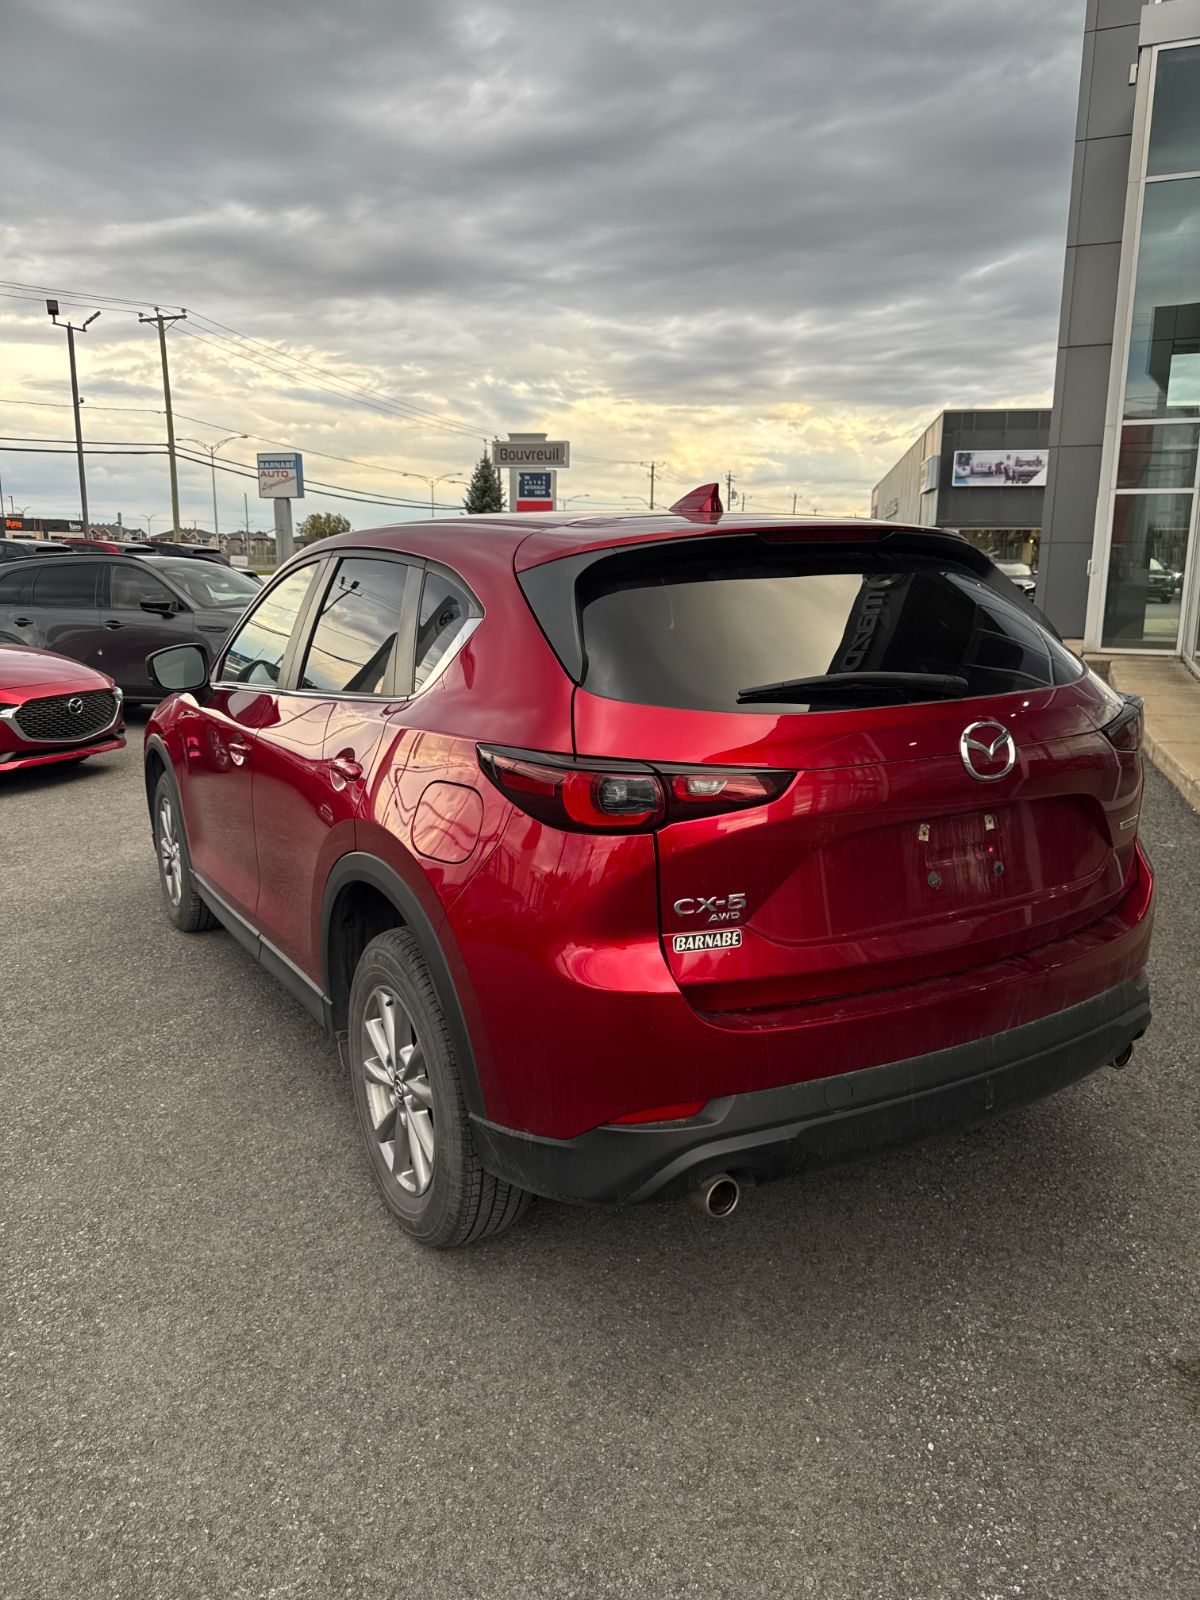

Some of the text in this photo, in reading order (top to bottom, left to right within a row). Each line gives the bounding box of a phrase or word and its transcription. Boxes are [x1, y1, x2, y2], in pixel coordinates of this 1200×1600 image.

[500, 447, 559, 461] Bouvreuil
[260, 470, 289, 478] AUTO
[673, 893, 747, 915] CX-5
[708, 911, 741, 922] AWD
[675, 932, 740, 951] BARNABE
